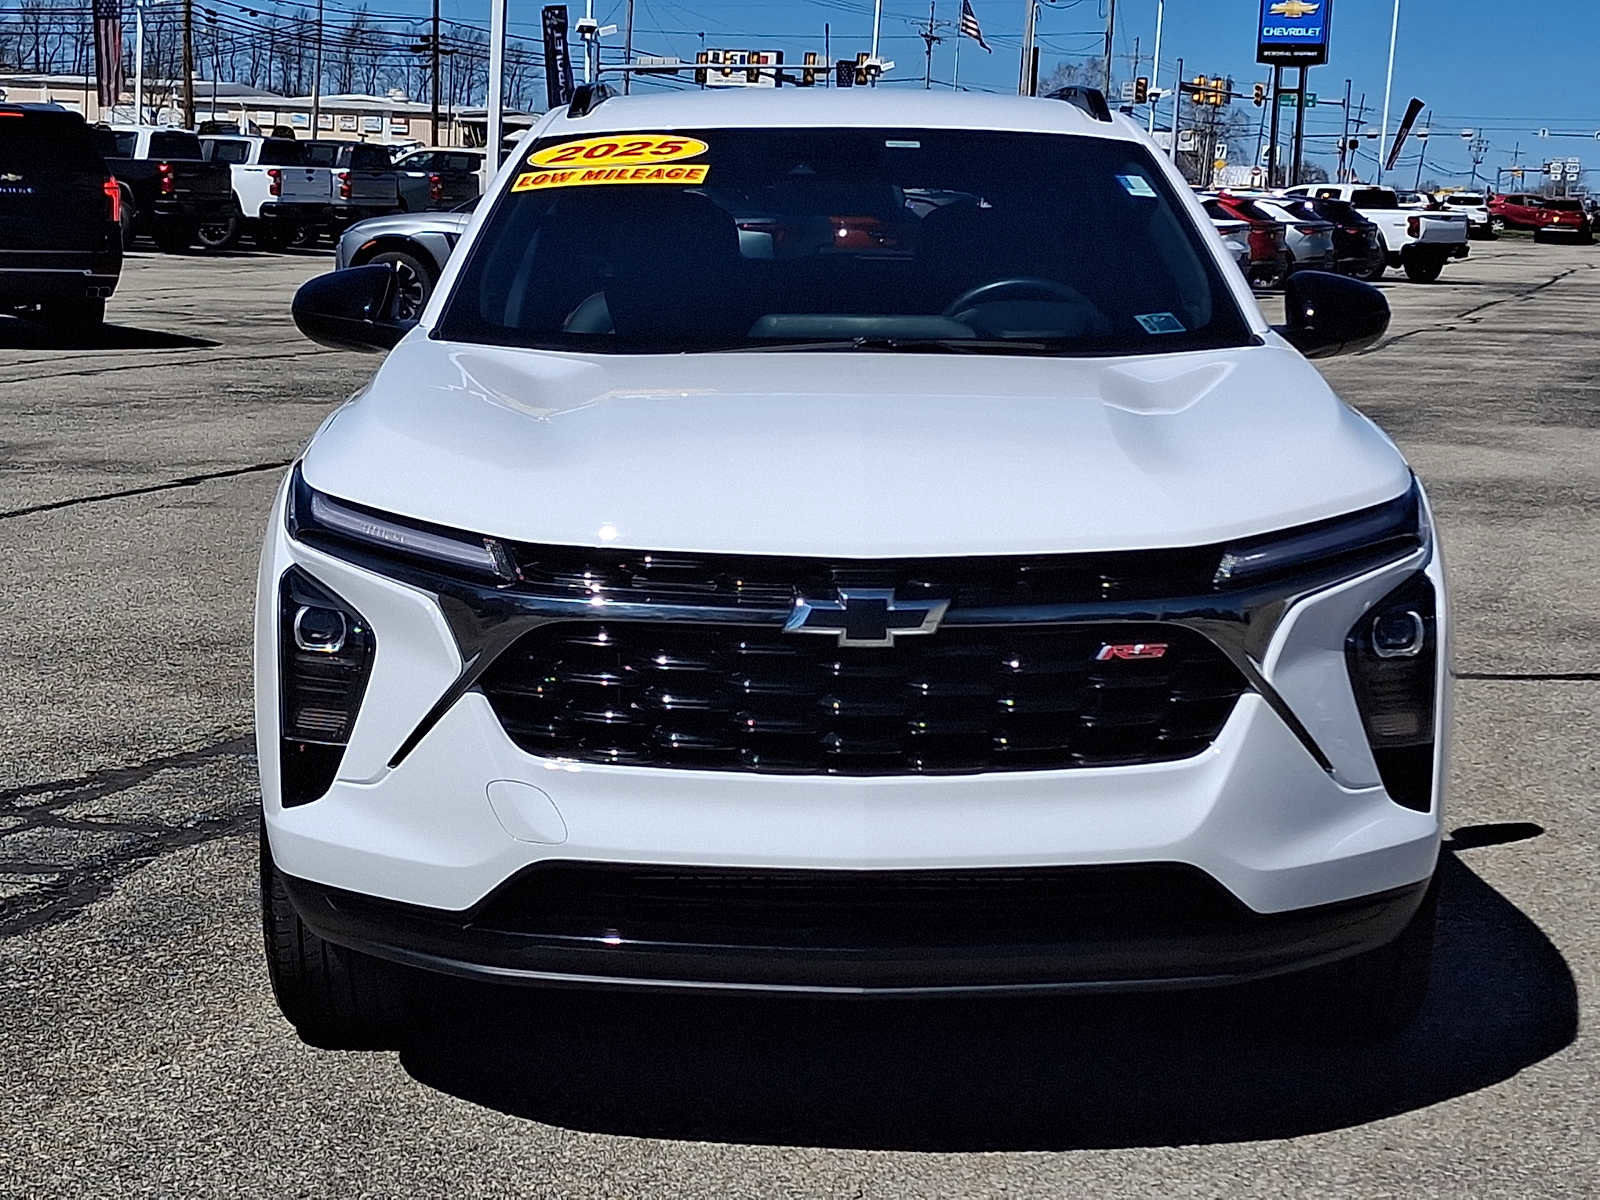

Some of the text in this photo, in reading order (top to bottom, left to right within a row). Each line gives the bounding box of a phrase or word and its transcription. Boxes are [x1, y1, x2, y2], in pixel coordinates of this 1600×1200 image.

[1263, 27, 1321, 37] CHEVROLET
[553, 30, 567, 105] EVROLET
[545, 140, 689, 164] 2025
[517, 168, 705, 188] LOW MILEAGE
[1096, 643, 1168, 660] RS
